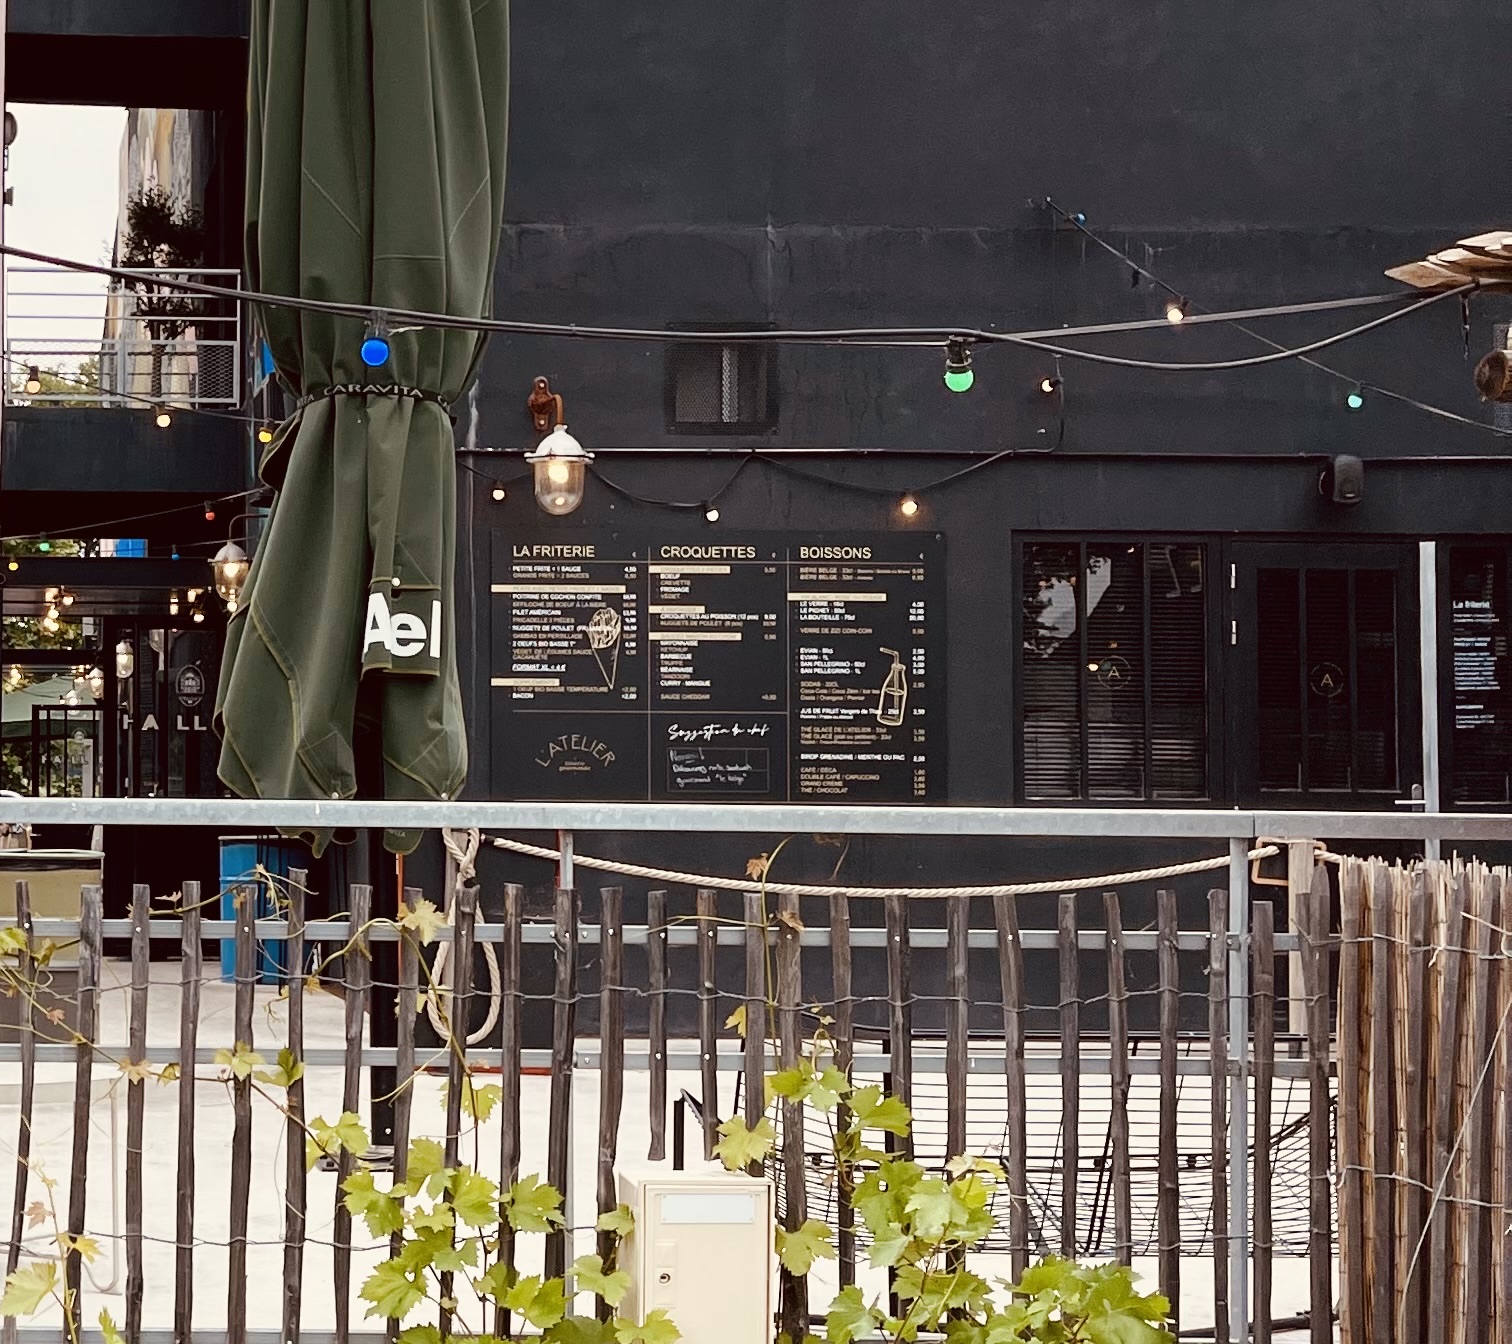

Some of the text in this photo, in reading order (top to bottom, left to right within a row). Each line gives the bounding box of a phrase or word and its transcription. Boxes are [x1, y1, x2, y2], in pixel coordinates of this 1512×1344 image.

[513, 545, 595, 558] LA FRITERIE
[660, 546, 756, 558] CROQUETTES
[800, 547, 872, 559] BOISSONS
[535, 734, 616, 767] L'ATELIER
